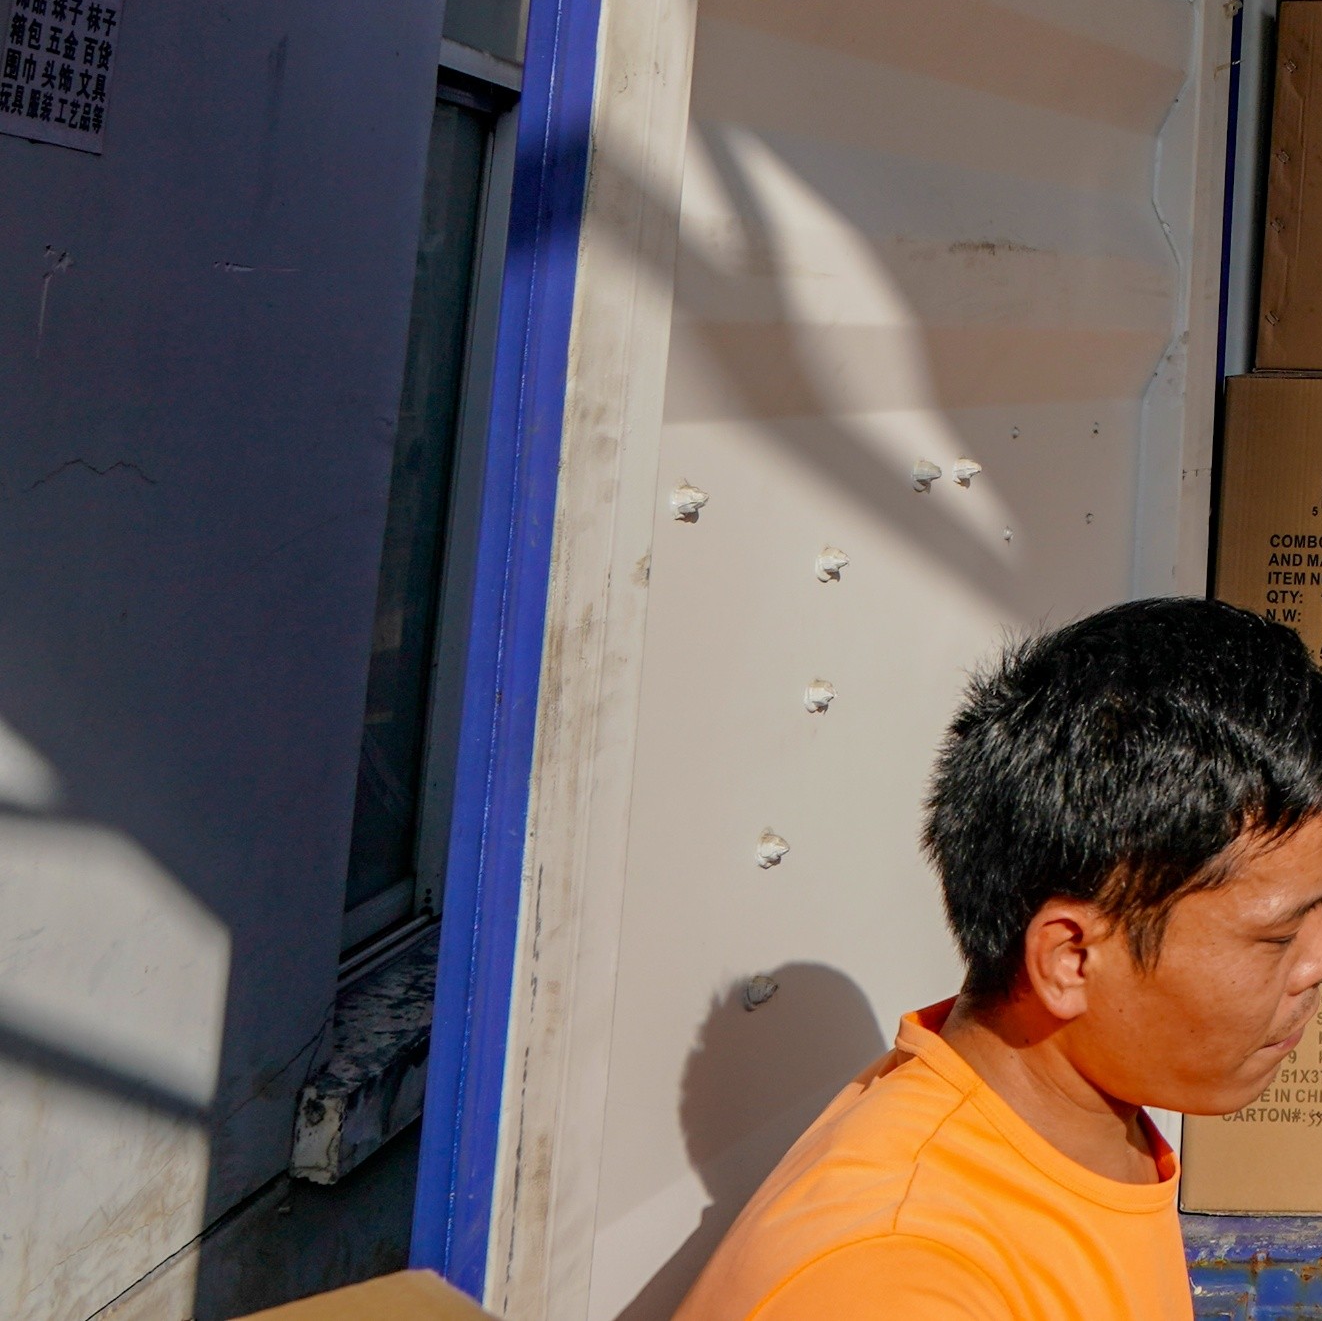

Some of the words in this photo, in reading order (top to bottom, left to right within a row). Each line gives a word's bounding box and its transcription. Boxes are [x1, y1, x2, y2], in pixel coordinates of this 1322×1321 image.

[10, 12, 43, 51] 箱包
[45, 26, 79, 61] 五金
[82, 36, 113, 71] 百货
[76, 69, 107, 103] 文具
[54, 98, 104, 133] 工艺品等
[1265, 590, 1304, 604] QTY:
